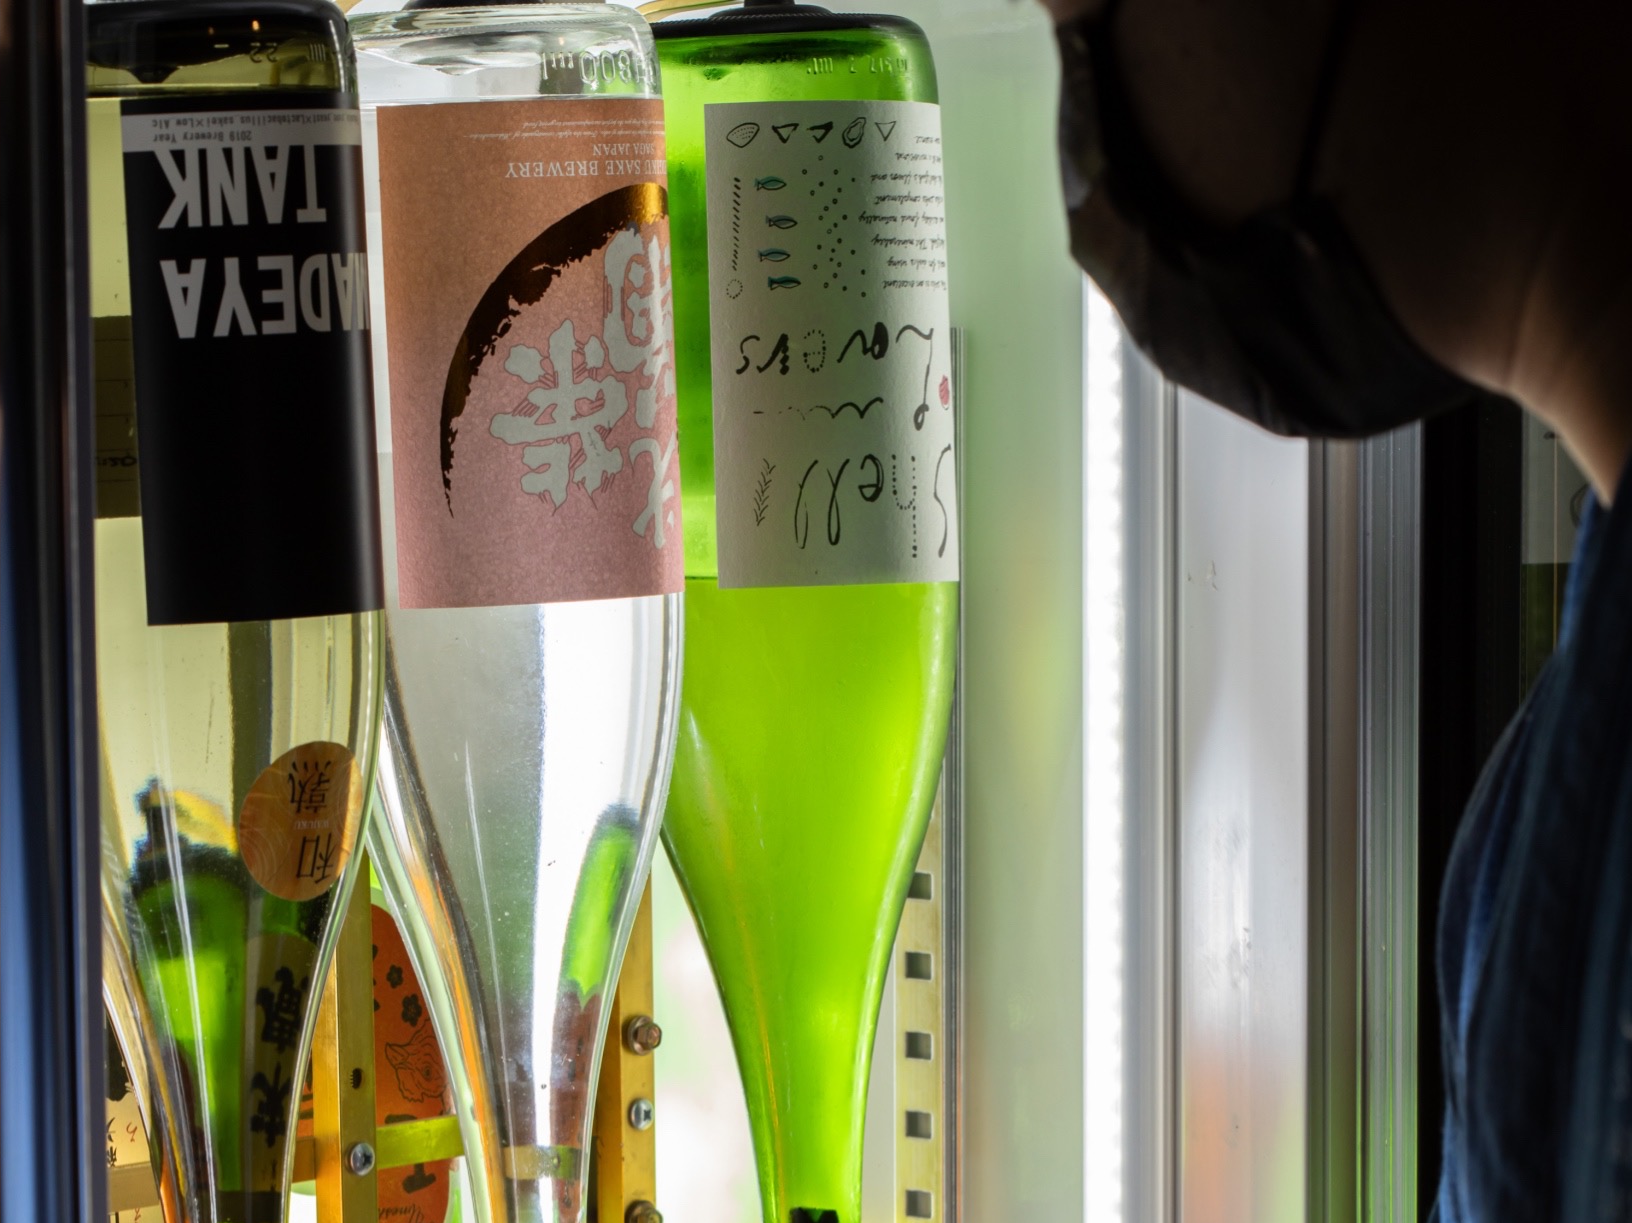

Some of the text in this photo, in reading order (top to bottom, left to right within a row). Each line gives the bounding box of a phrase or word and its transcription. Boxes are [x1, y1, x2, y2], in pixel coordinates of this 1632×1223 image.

[153, 132, 177, 144] Year
[183, 131, 224, 143] Brewery
[592, 143, 655, 156] SAGA JAPAN
[504, 160, 598, 178] BREWERY
[605, 159, 641, 176] SAKE
[153, 145, 327, 229] TANK
[288, 761, 331, 814] 熟
[296, 832, 337, 884] 和
